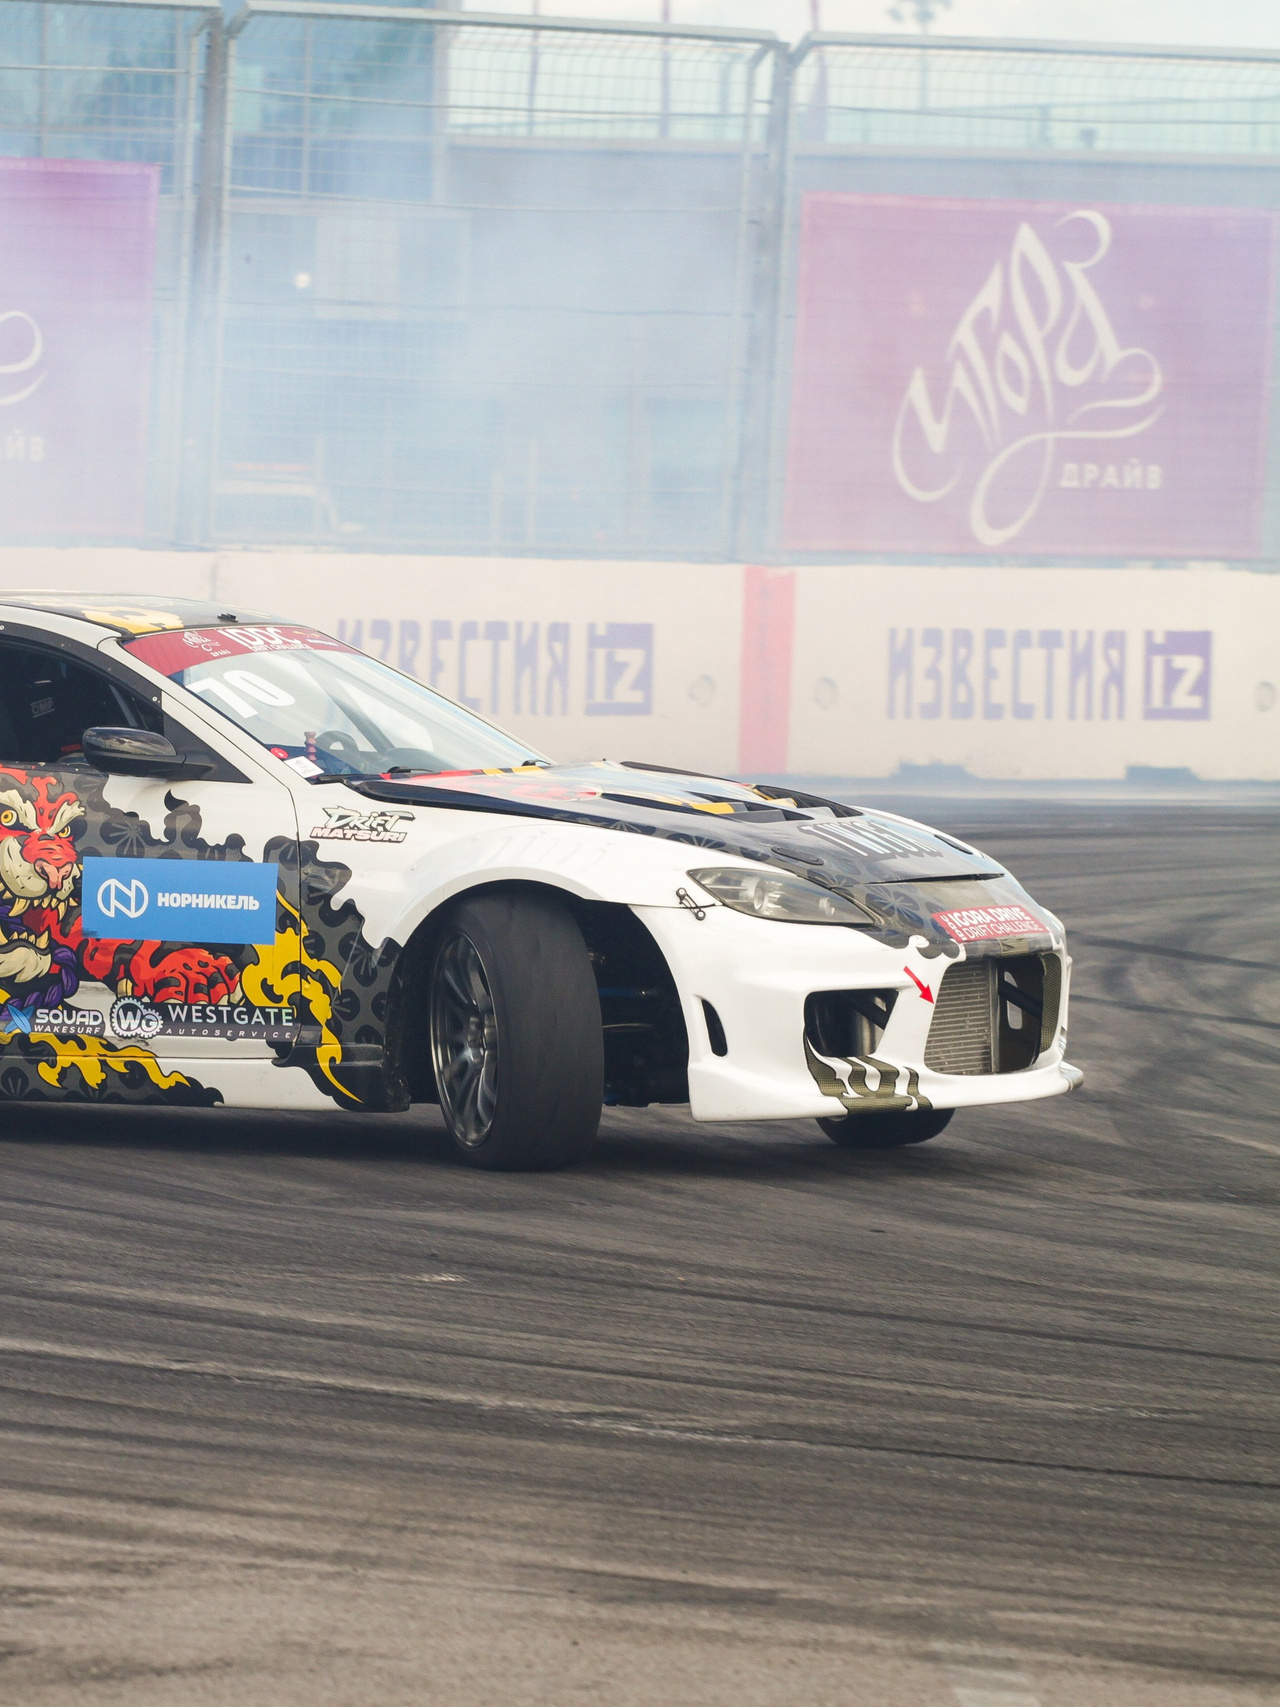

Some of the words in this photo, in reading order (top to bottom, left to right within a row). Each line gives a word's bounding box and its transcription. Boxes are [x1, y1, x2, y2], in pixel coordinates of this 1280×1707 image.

[1059, 457, 1164, 490] ДРАЙВ
[217, 627, 302, 648] IDDC
[886, 626, 1128, 721] ИЗВЕСТИЯ
[184, 669, 296, 719] 70
[31, 700, 54, 714] OMP
[310, 827, 408, 843] MATSURI
[157, 892, 260, 911] НОРНИКЕЛЬ
[948, 909, 990, 928] IGORA
[987, 906, 1032, 921] DRIVE
[963, 923, 994, 939] DRIFT
[991, 920, 1043, 935] CHALLENGE
[36, 1009, 103, 1026] SQUAD
[120, 1008, 159, 1031] WG
[168, 1004, 293, 1026] WESTGATE
[34, 1025, 101, 1034] WAKESURF
[166, 1028, 292, 1039] AUTOSERVICE
